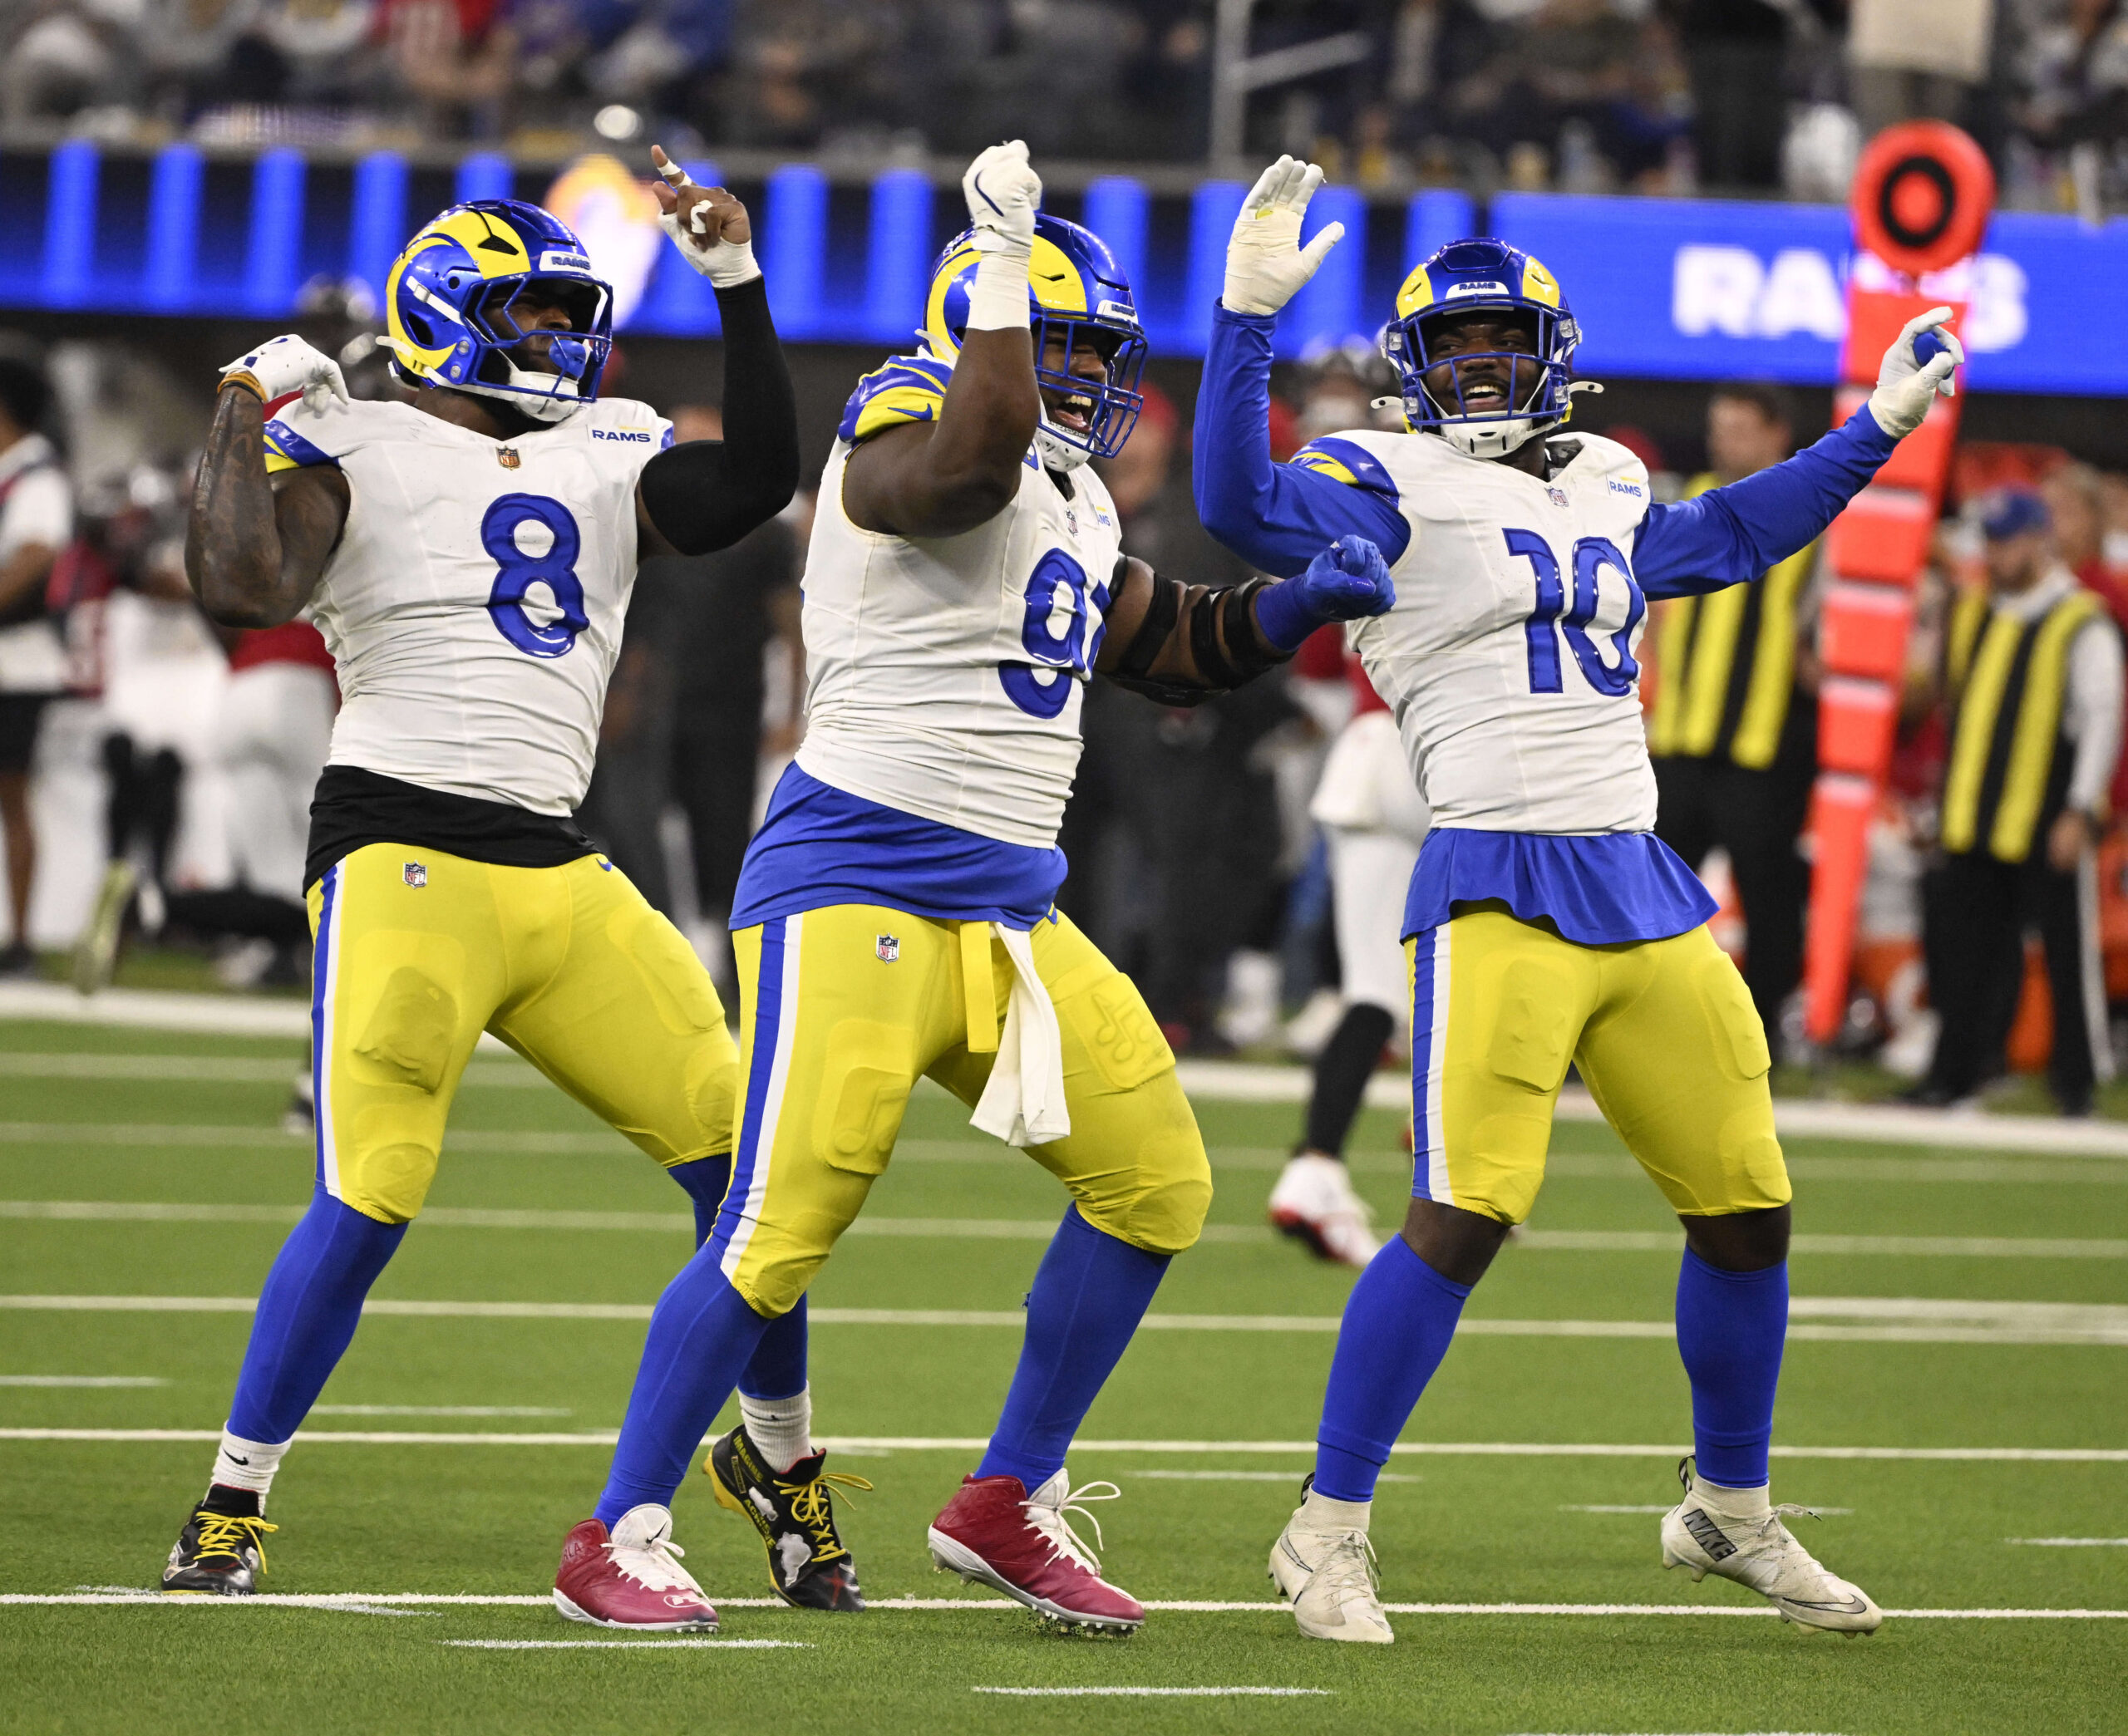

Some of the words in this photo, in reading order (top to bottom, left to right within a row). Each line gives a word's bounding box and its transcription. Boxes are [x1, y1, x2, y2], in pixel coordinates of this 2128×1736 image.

[551, 256, 591, 270] RAMS
[1459, 282, 1497, 291] RAMS
[1672, 244, 2028, 353] RAS
[591, 429, 651, 442] RAMS
[1608, 480, 1642, 498] RAMS
[480, 492, 590, 659] 8
[1501, 527, 1646, 697] 10
[1682, 1507, 1738, 1562] NIKE
